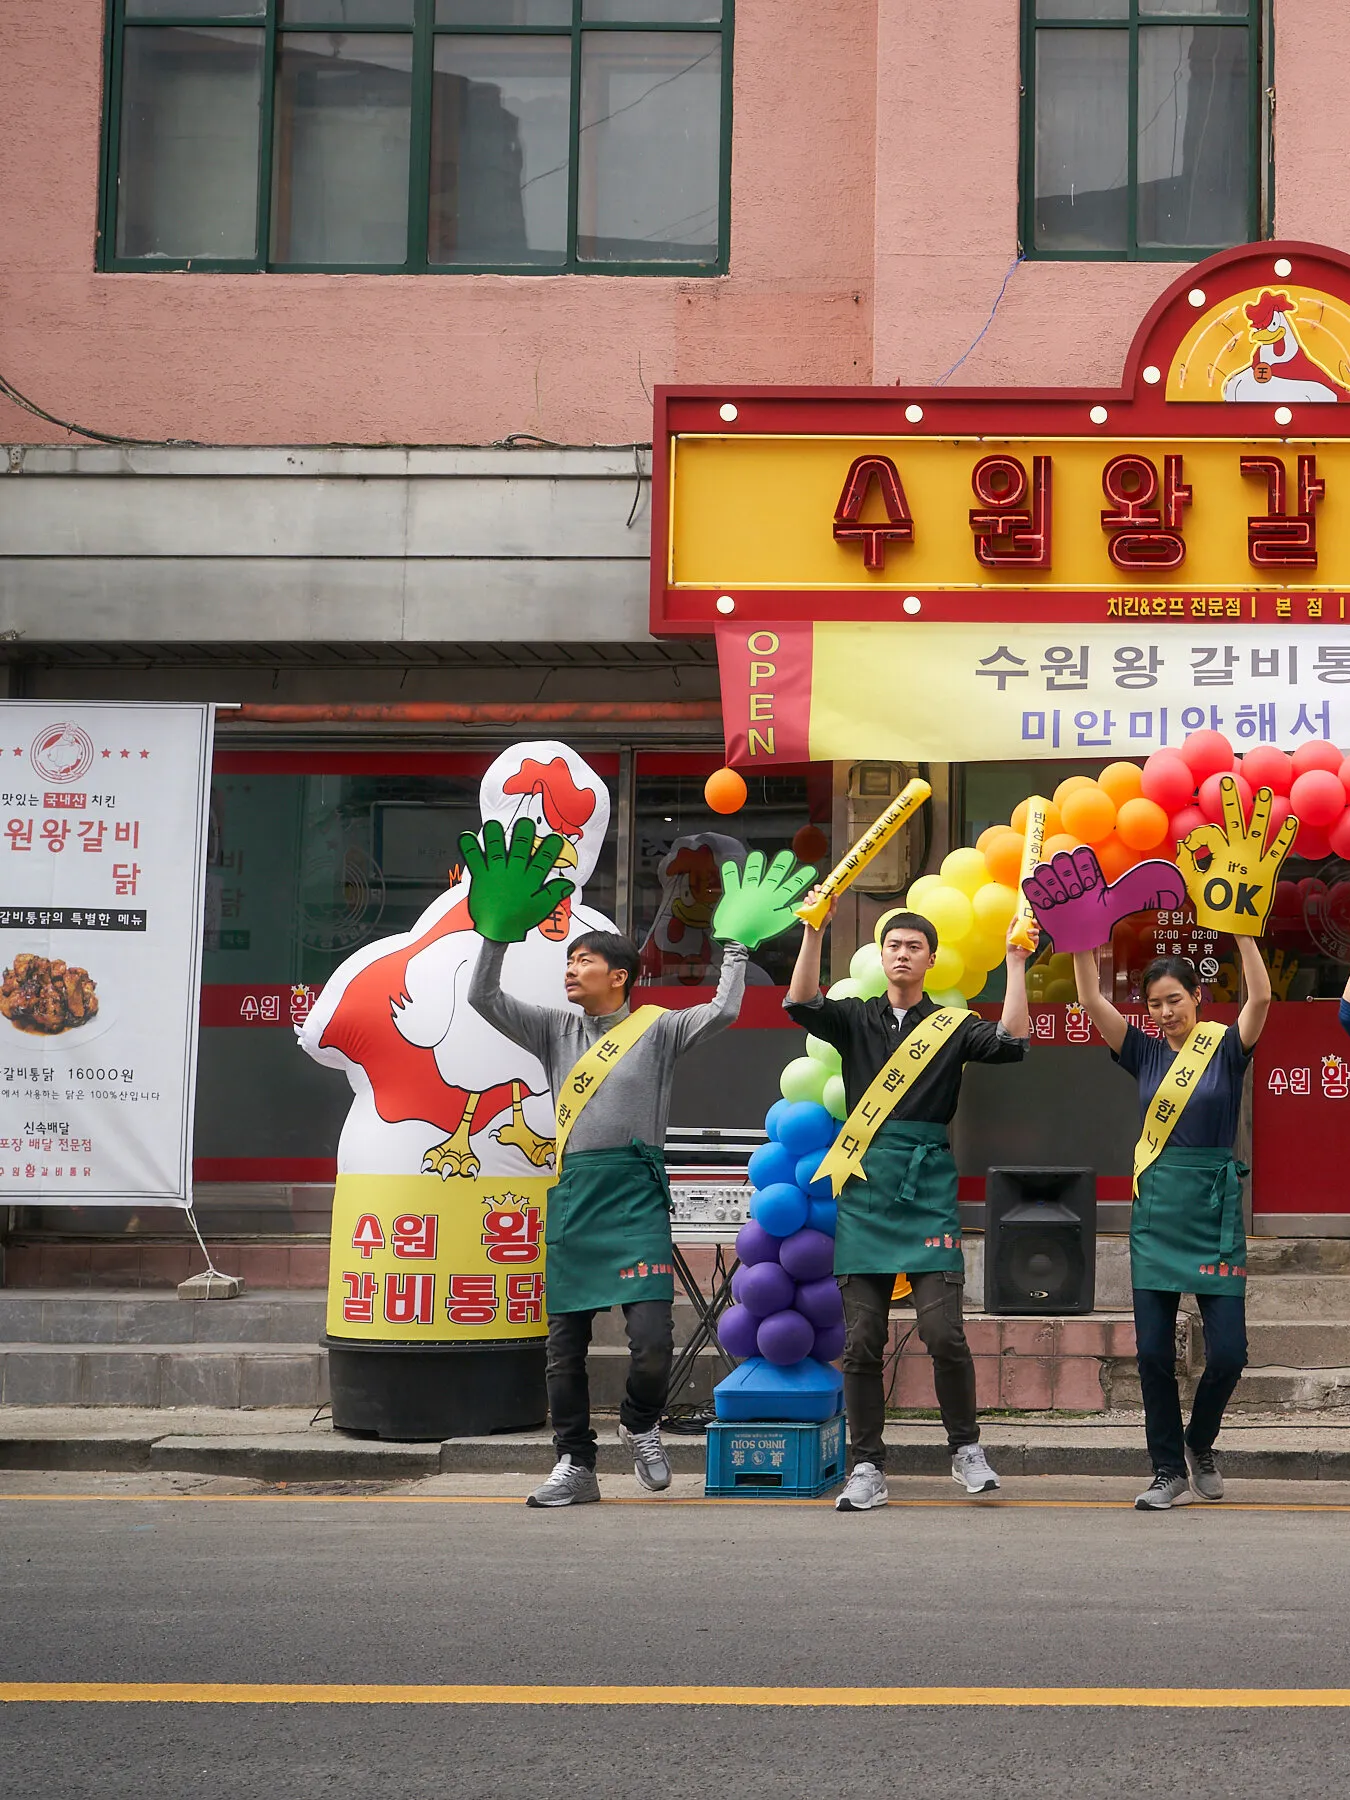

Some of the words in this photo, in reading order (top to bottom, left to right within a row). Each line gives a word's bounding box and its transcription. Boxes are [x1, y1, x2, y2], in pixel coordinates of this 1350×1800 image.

[1107, 596, 1185, 617] 치킨&호프
[1190, 596, 1241, 617] 전문점
[746, 630, 781, 757] OPEN
[2, 793, 39, 807] 맛있는
[45, 794, 86, 808] 국내산
[92, 795, 116, 809] 치킨
[1227, 860, 1248, 875] it's
[112, 863, 141, 896] 닭
[1204, 877, 1263, 917] OK
[71, 912, 110, 926] 특별한
[118, 913, 143, 926] 메뉴
[1153, 929, 1179, 940] 12:00
[1191, 929, 1218, 940] 02:00
[240, 995, 280, 1020] 수원
[1028, 1013, 1055, 1039] 원
[3, 1067, 54, 1082] 갈비통닭
[68, 1068, 134, 1083] 16000원
[1268, 1067, 1311, 1095] 수원
[25, 1089, 59, 1100] 사용하는
[65, 1090, 85, 1100] 닭은
[841, 1012, 954, 1160] 반성합니다
[1134, 1032, 1213, 1175] 반성합니
[24, 1121, 70, 1135] 신속배달
[0, 1138, 23, 1152] 포장
[29, 1138, 53, 1152] 배달
[58, 1138, 92, 1152] 전문점
[352, 1212, 439, 1260] 수원
[481, 1203, 545, 1264] 왕
[342, 1271, 546, 1325] 갈비통닭
[731, 1440, 756, 1449] SOJU
[758, 1439, 787, 1449] JINRO
